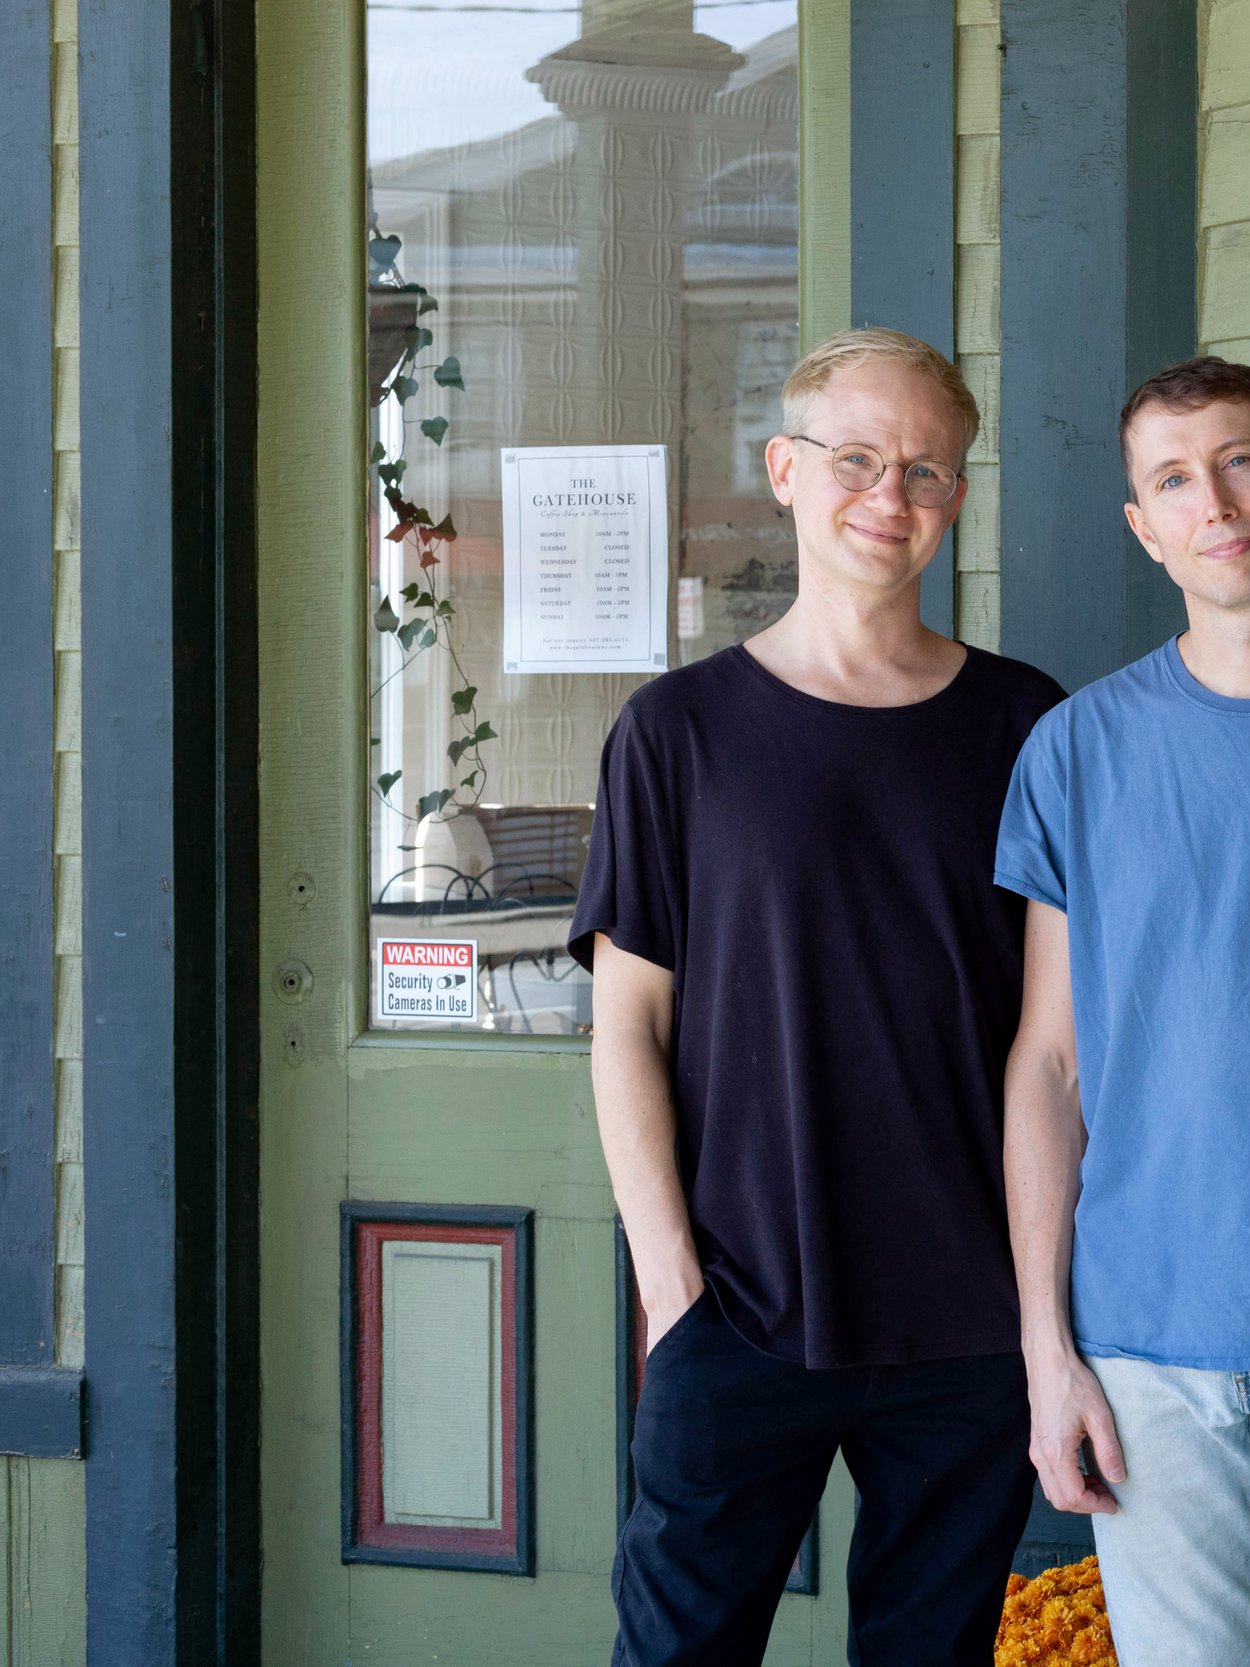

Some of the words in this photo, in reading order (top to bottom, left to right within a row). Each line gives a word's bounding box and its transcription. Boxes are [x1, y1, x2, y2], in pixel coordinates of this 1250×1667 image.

[570, 478, 597, 489] THE
[532, 492, 637, 507] GATEHOUSE
[563, 508, 579, 518] Shop
[386, 945, 469, 965] WARNING
[388, 971, 433, 993] Security
[388, 993, 432, 1011] Cameras
[436, 995, 445, 1011] In
[449, 995, 467, 1012] Use
